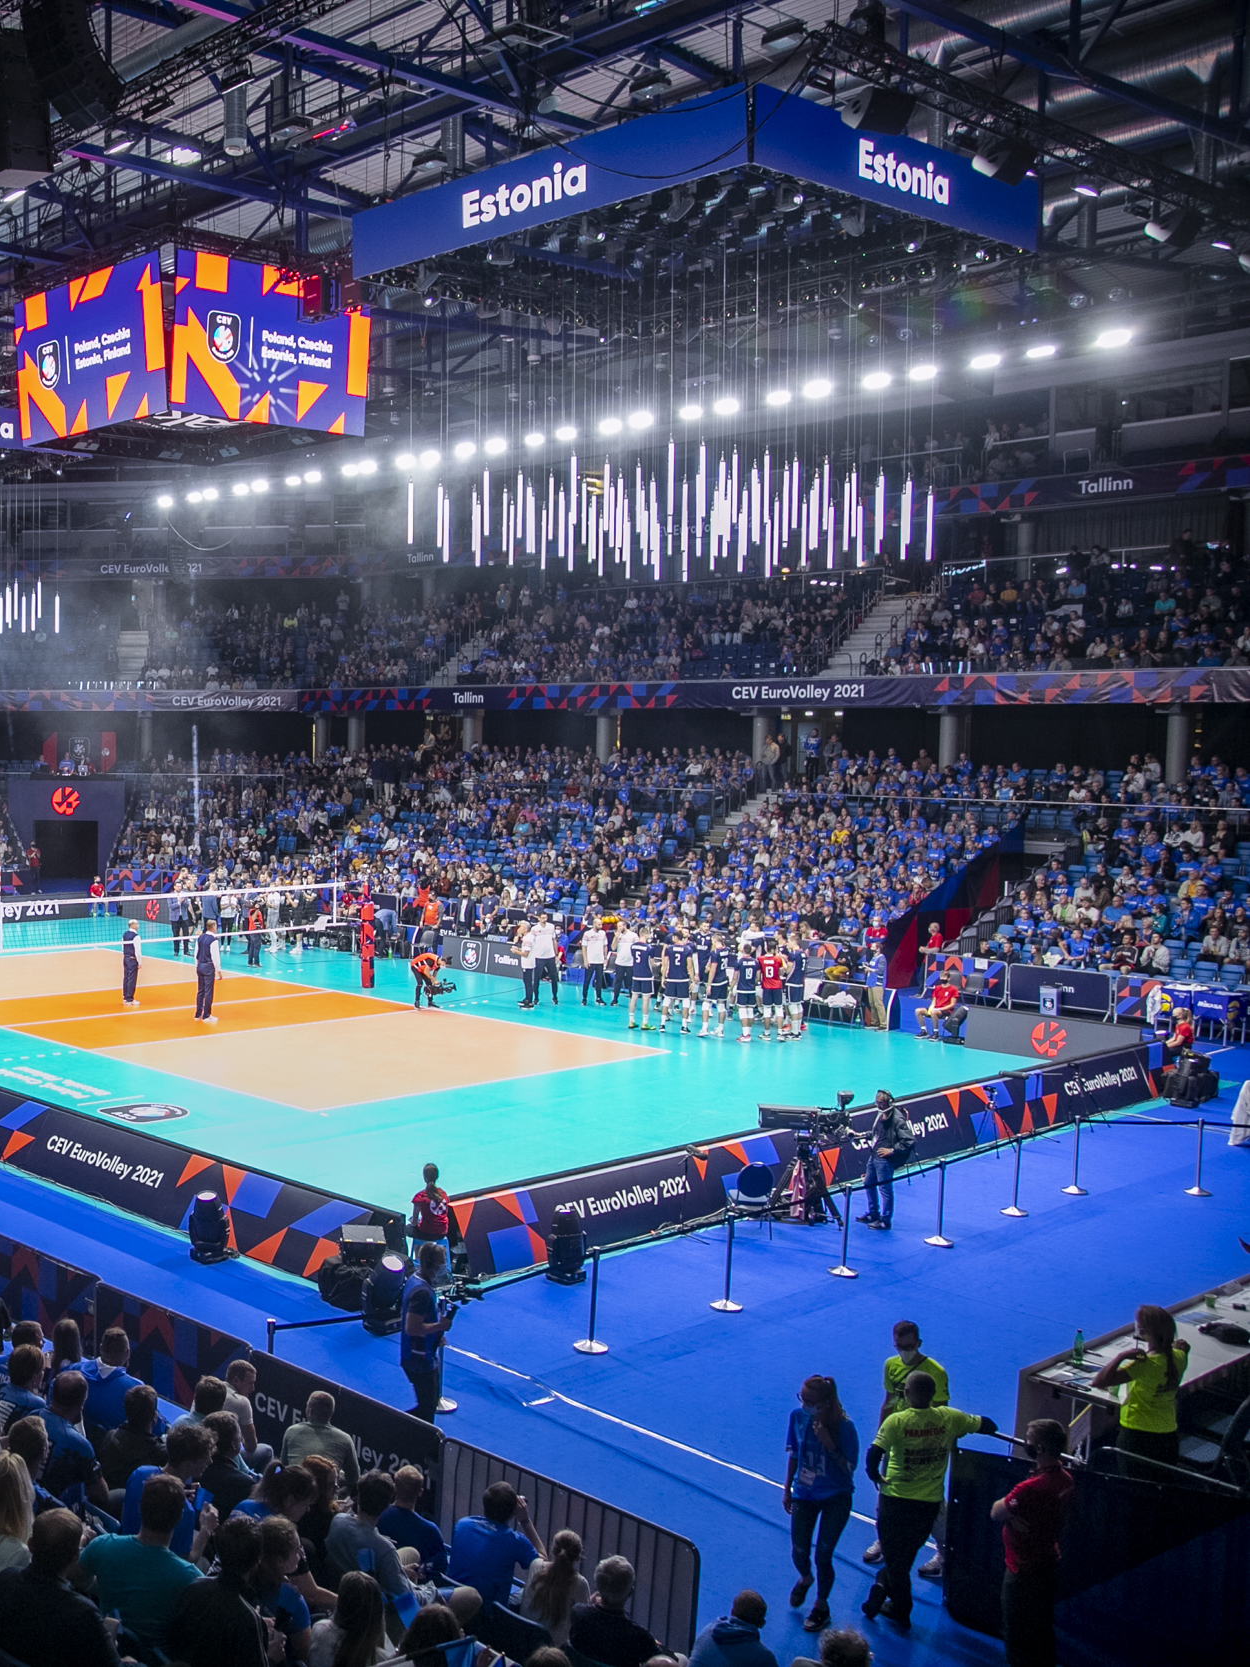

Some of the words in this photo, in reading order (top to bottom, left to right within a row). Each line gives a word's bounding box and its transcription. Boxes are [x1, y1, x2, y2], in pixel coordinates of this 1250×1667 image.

[859, 138, 949, 205] Estonia
[462, 163, 587, 229] Estonia
[74, 336, 101, 354] Poland,
[101, 327, 130, 346] Czechia
[262, 330, 296, 348] Poland,
[298, 336, 333, 354] Czechia
[75, 352, 103, 370] Estonia,
[103, 342, 131, 361] Finland
[261, 346, 297, 364] Estonia,
[298, 352, 331, 369] Finland
[1078, 477, 1133, 494] Tallinn
[407, 552, 434, 563] Tallinn
[100, 564, 122, 574] CEV
[123, 563, 169, 574] EuroVolle
[453, 691, 484, 704] Tallinn
[731, 686, 758, 699] CEV
[761, 684, 830, 701] EuroVolley
[833, 684, 865, 698] 2021
[172, 696, 195, 706] CEV
[197, 695, 254, 709] EuroVolley
[256, 696, 281, 706] 2021
[26, 901, 60, 916] 2021
[494, 954, 518, 966] Tallinn
[635, 951, 641, 963] 5
[675, 954, 681, 965] 2
[765, 966, 774, 978] 13
[1119, 1066, 1138, 1082] 2021
[924, 1112, 949, 1132] 2021
[46, 1135, 73, 1156] CEV
[70, 1143, 132, 1180] EuroVolley
[131, 1165, 164, 1189] 2021
[586, 1185, 658, 1216] EuroVolley
[659, 1175, 691, 1198] 2021
[254, 1392, 288, 1423] CEV
[904, 1426, 946, 1438] PARAMEDIC
